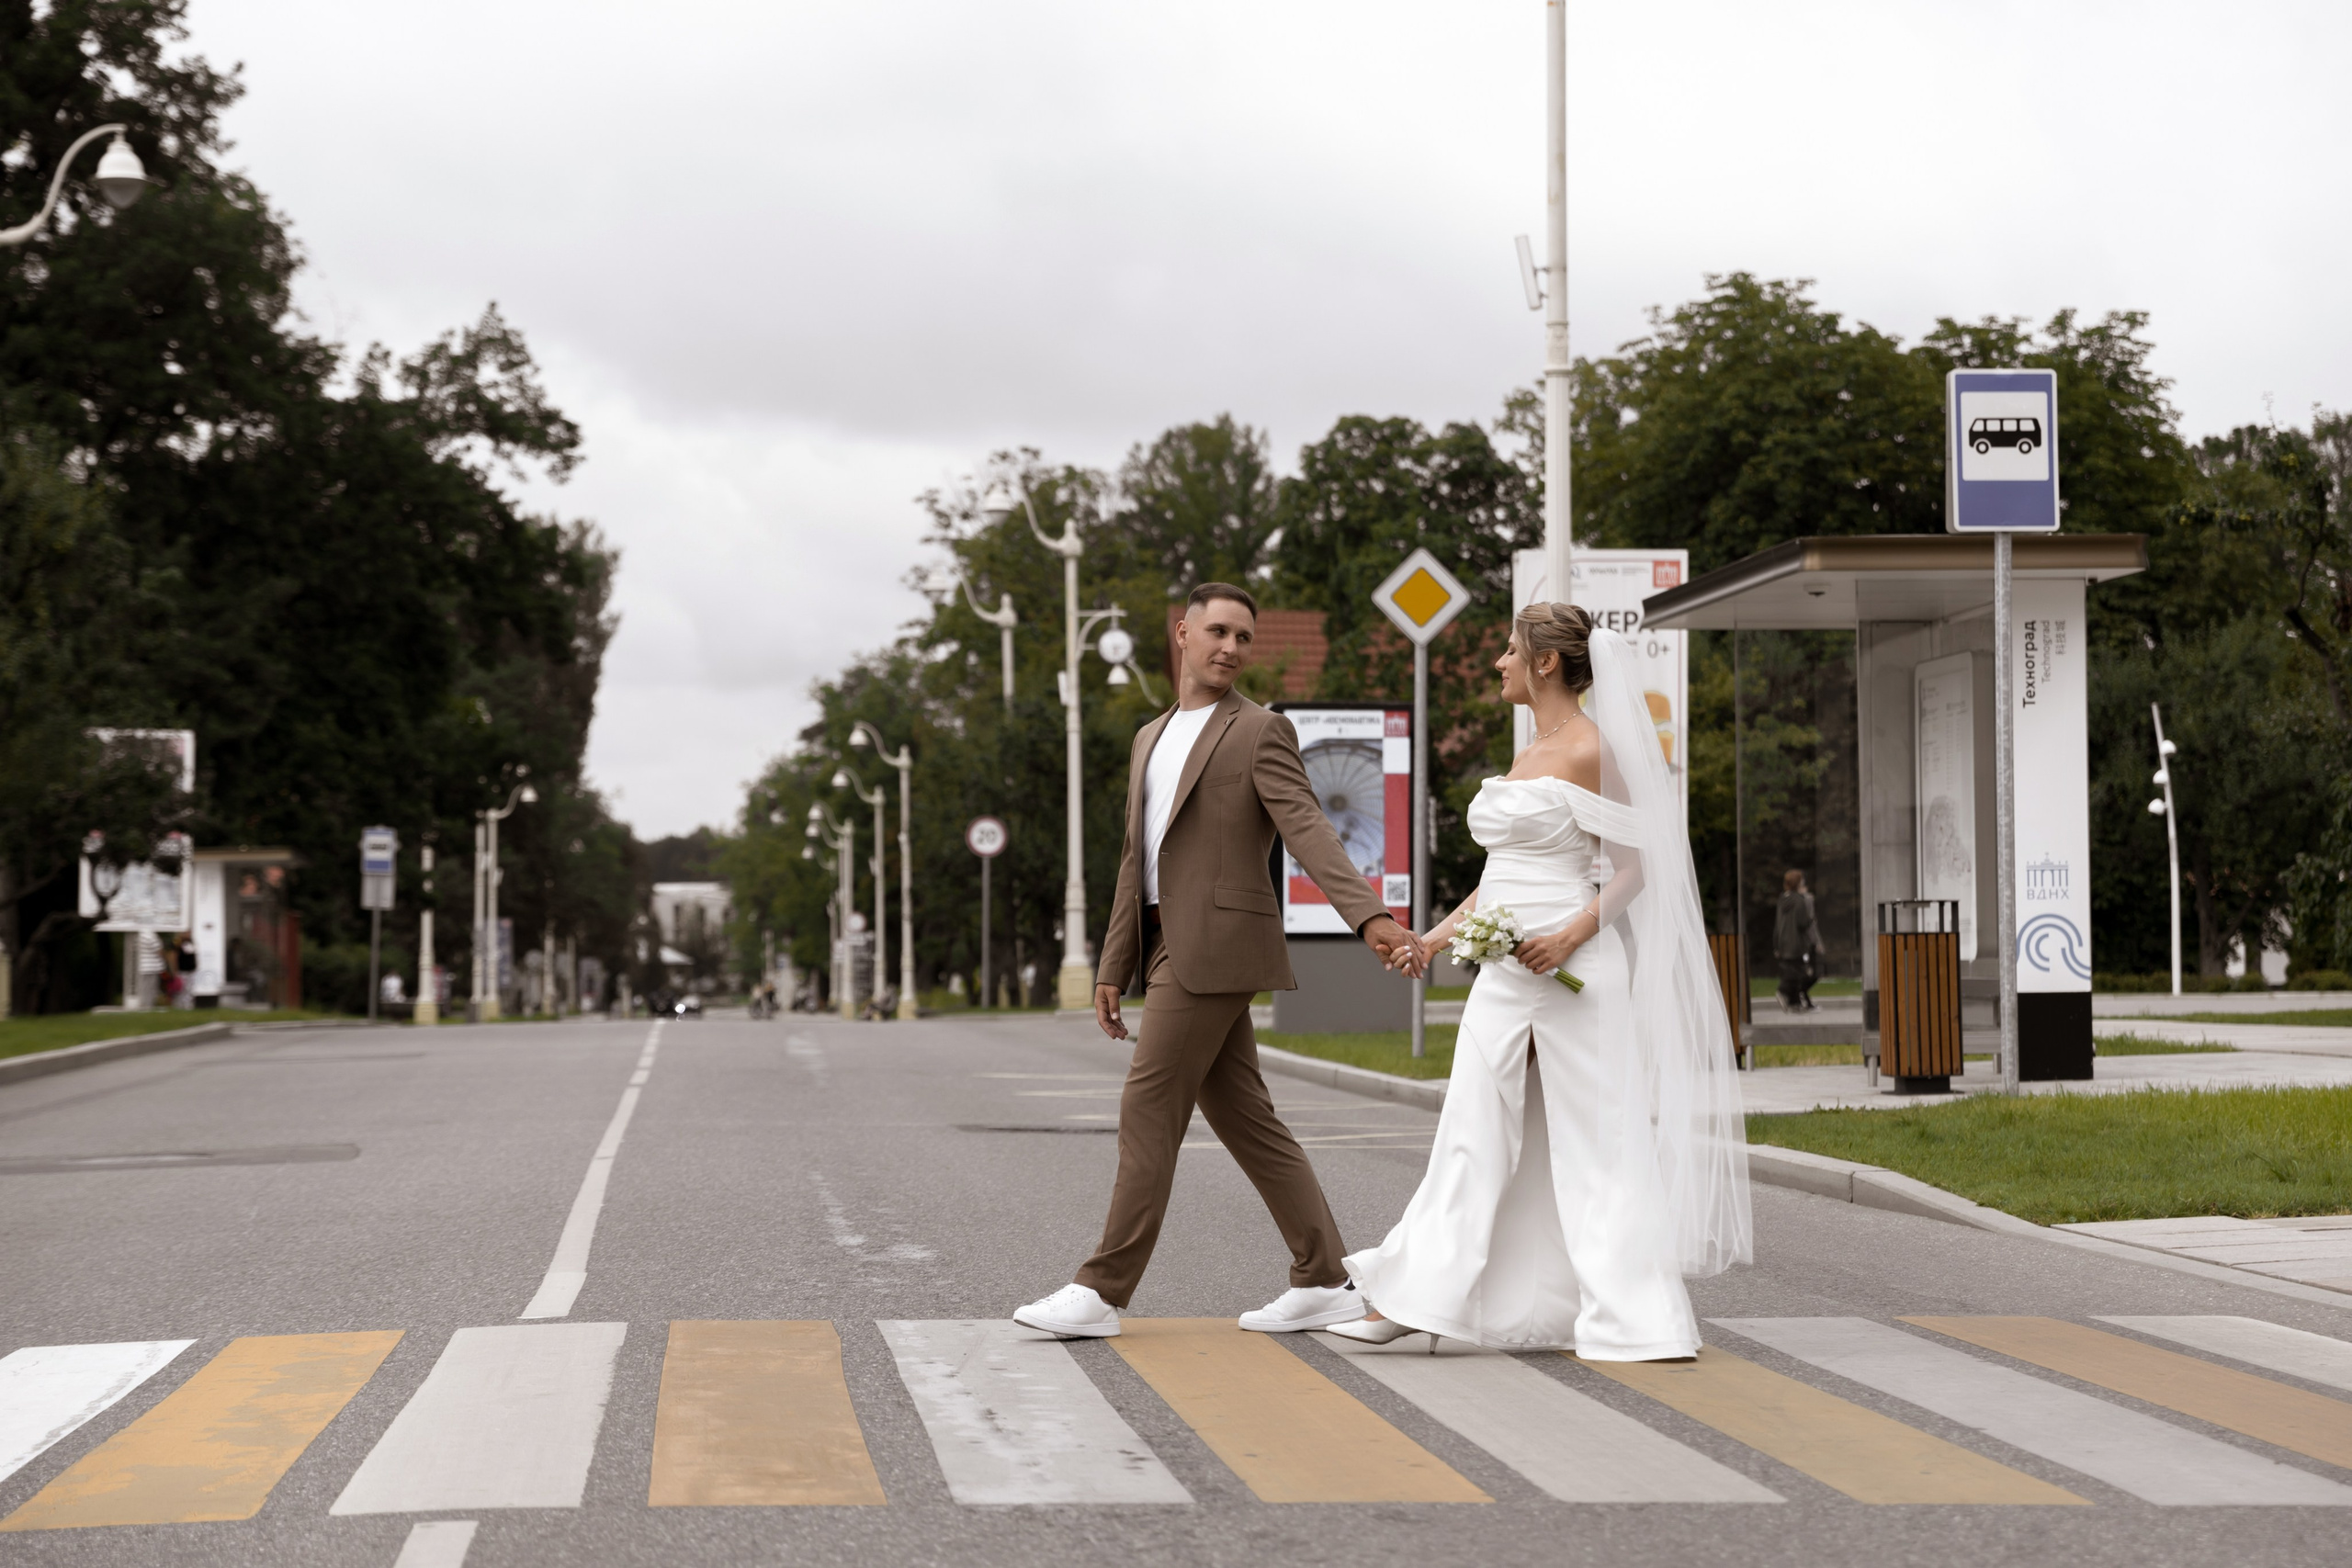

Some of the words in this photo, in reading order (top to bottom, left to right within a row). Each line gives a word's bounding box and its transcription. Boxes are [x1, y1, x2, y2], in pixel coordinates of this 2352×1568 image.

[1590, 611, 1656, 633] КЕР
[1646, 640, 1670, 659] 0+
[2041, 620, 2052, 683] Technograd
[2023, 620, 2038, 708] Техноград
[977, 828, 998, 844] 20
[2027, 888, 2069, 900] ВДНХ
